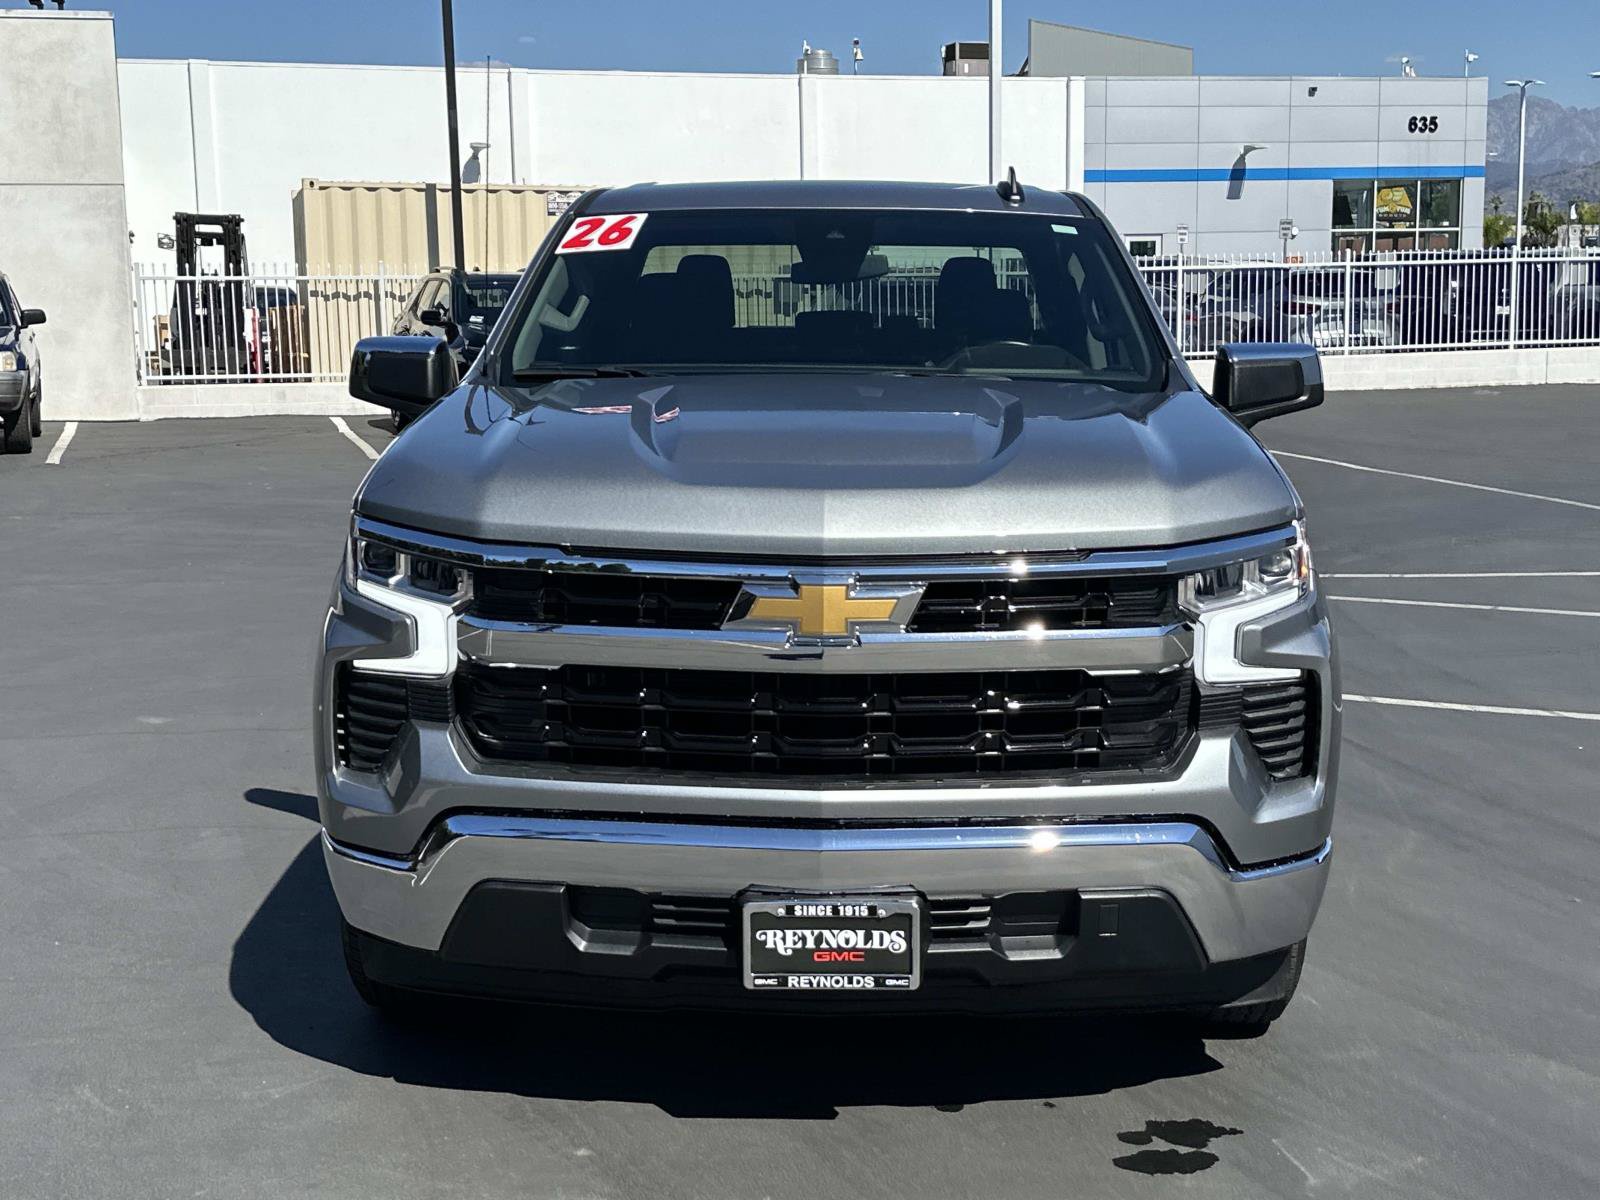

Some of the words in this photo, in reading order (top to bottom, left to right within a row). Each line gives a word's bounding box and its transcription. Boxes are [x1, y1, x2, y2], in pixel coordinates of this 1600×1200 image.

[1408, 116, 1438, 133] 635
[561, 215, 638, 249] 26
[794, 905, 833, 916] SINCE
[838, 905, 868, 916] 1915
[756, 929, 907, 956] REYNOLDS
[814, 951, 865, 962] GMC
[788, 976, 875, 988] REYNOLDS
